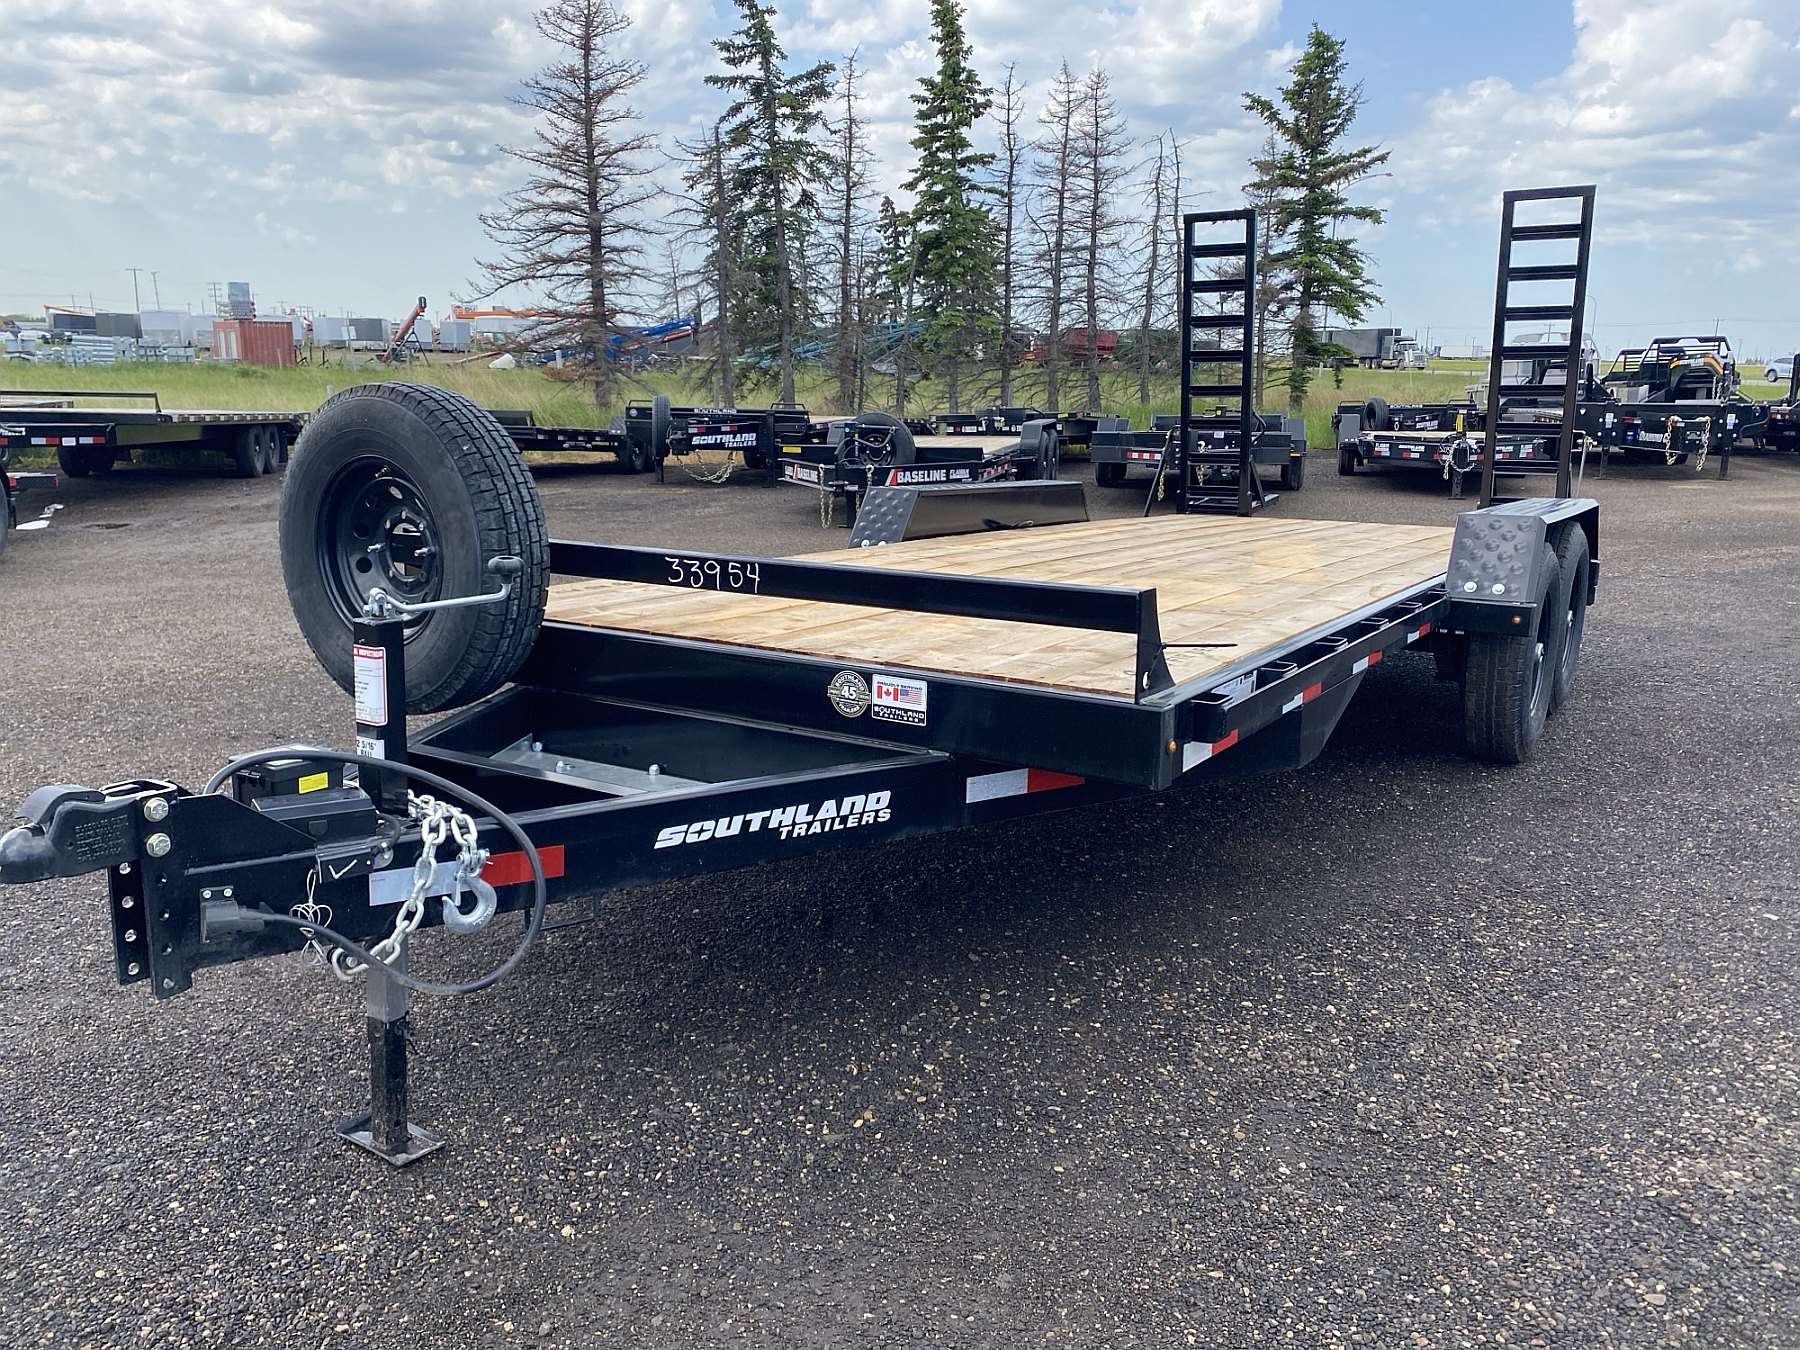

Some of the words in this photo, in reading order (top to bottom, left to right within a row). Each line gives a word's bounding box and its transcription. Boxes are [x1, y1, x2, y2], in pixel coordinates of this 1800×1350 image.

[692, 433, 757, 445] SOUTHLAND
[724, 440, 757, 448] TRAILERS
[897, 469, 947, 483] BASELINE
[664, 556, 761, 594] 33954
[841, 685, 857, 700] 45
[873, 705, 925, 719] SOUTHLAND
[653, 789, 892, 850] SOUTHLAND
[779, 808, 892, 841] TRAILERS
